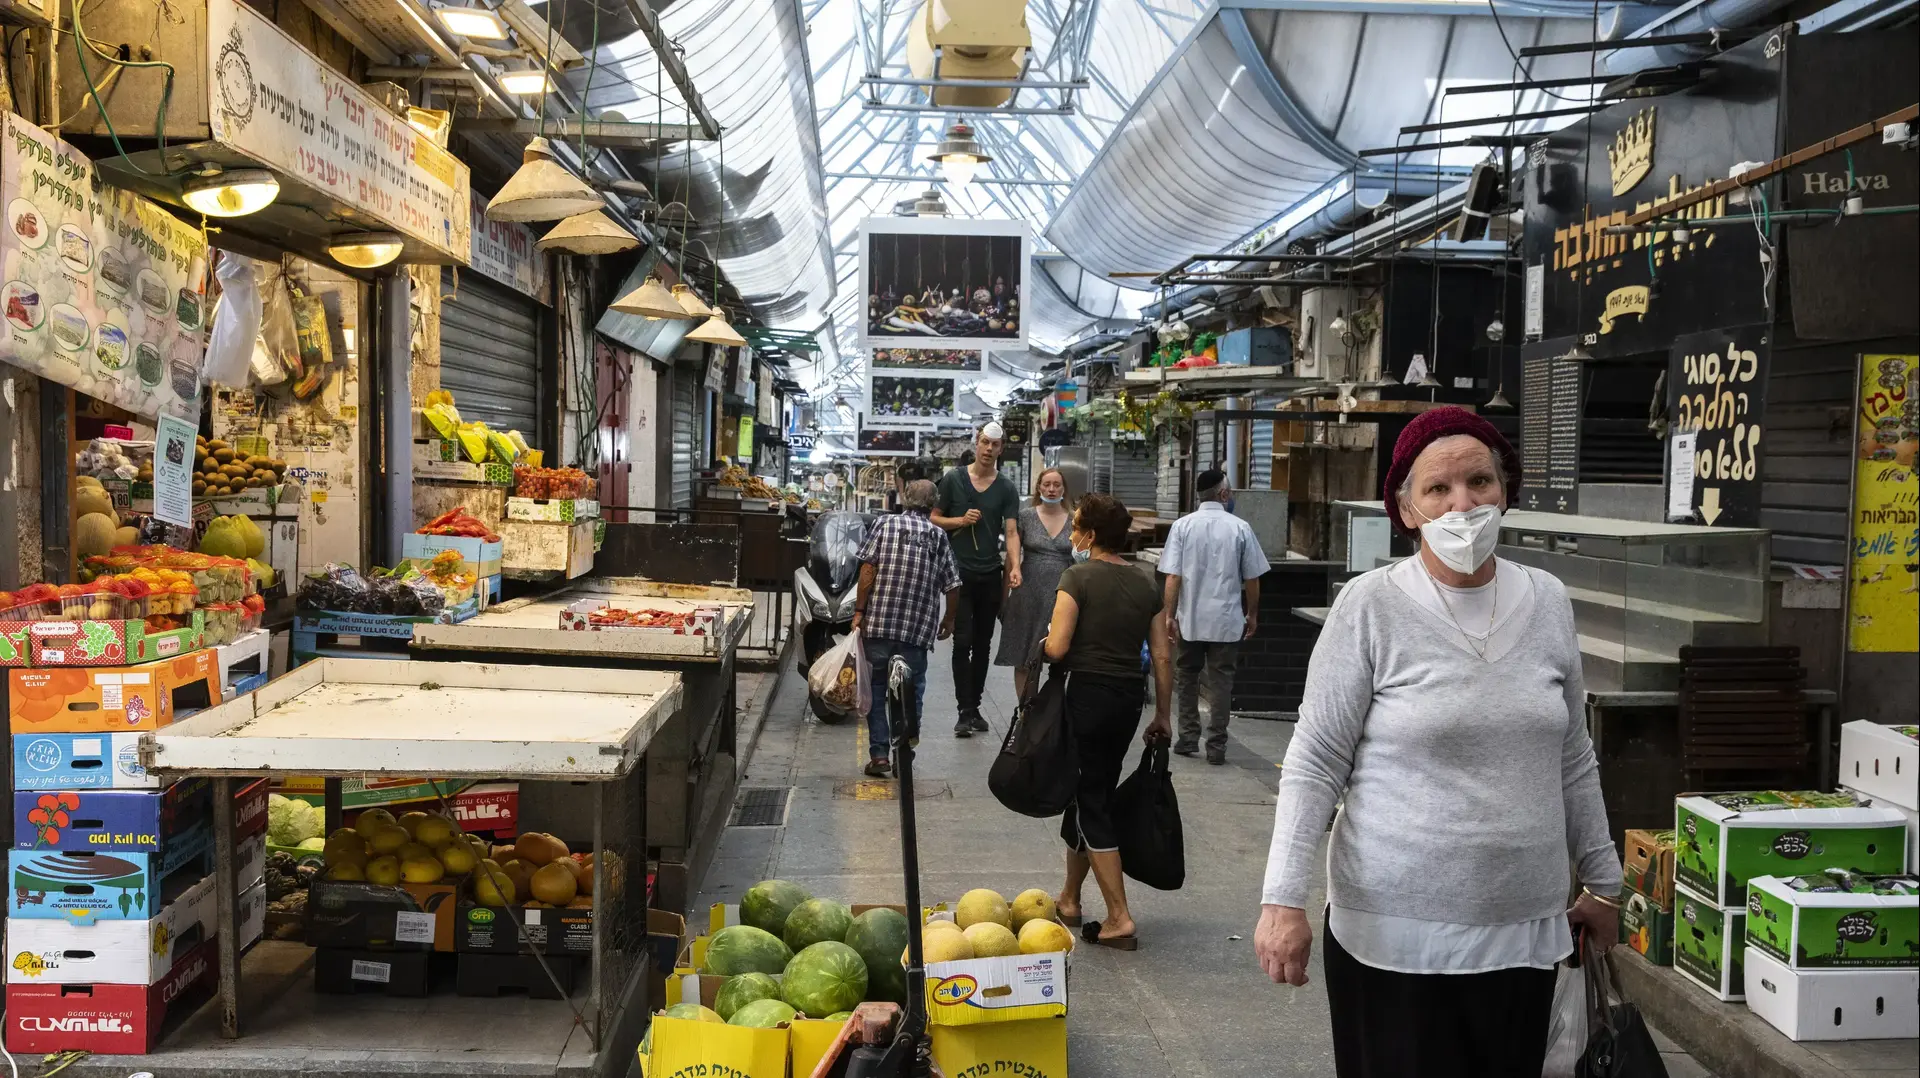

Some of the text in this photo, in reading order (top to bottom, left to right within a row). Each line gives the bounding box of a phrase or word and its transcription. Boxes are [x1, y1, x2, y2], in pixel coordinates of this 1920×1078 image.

[259, 81, 296, 127] ושביעית
[298, 98, 315, 136] טבל
[320, 115, 340, 151] ערלה
[32, 168, 84, 213] מהדרין
[1802, 171, 1890, 196] Halva
[1683, 342, 1758, 386] כל סוגי
[1678, 374, 1749, 432] החלבה
[1715, 422, 1761, 482] ללא
[1860, 507, 1917, 525] הבריאות
[88, 832, 157, 846] ממן ציון וטל
[1774, 843, 1810, 855] הכפר
[1838, 925, 1875, 937] הכפר
[1843, 915, 1869, 926] יבולי
